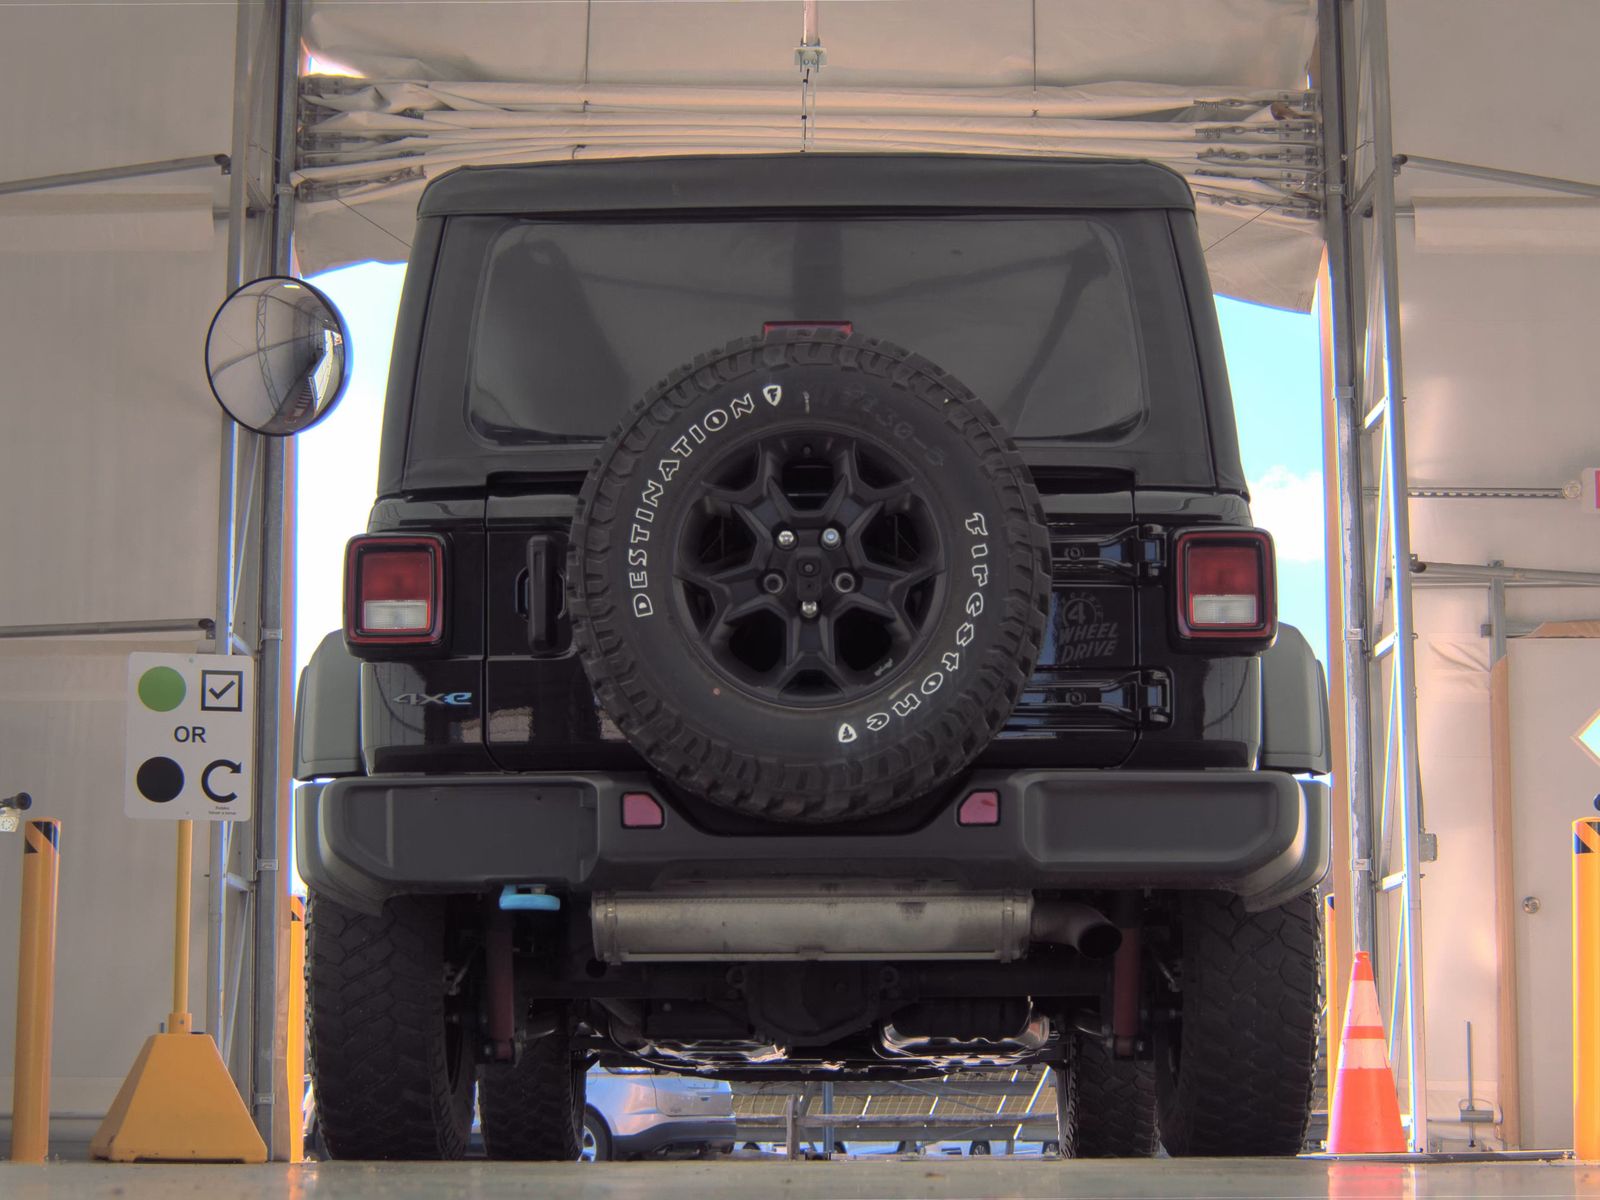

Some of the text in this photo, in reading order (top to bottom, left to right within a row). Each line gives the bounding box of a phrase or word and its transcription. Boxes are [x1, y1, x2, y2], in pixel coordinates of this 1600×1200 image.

[628, 393, 755, 617] DESTINATION
[1067, 602, 1086, 624] 4
[1060, 622, 1119, 643] WHEEL
[1060, 641, 1117, 664] DRIVE
[174, 725, 206, 743] OR
